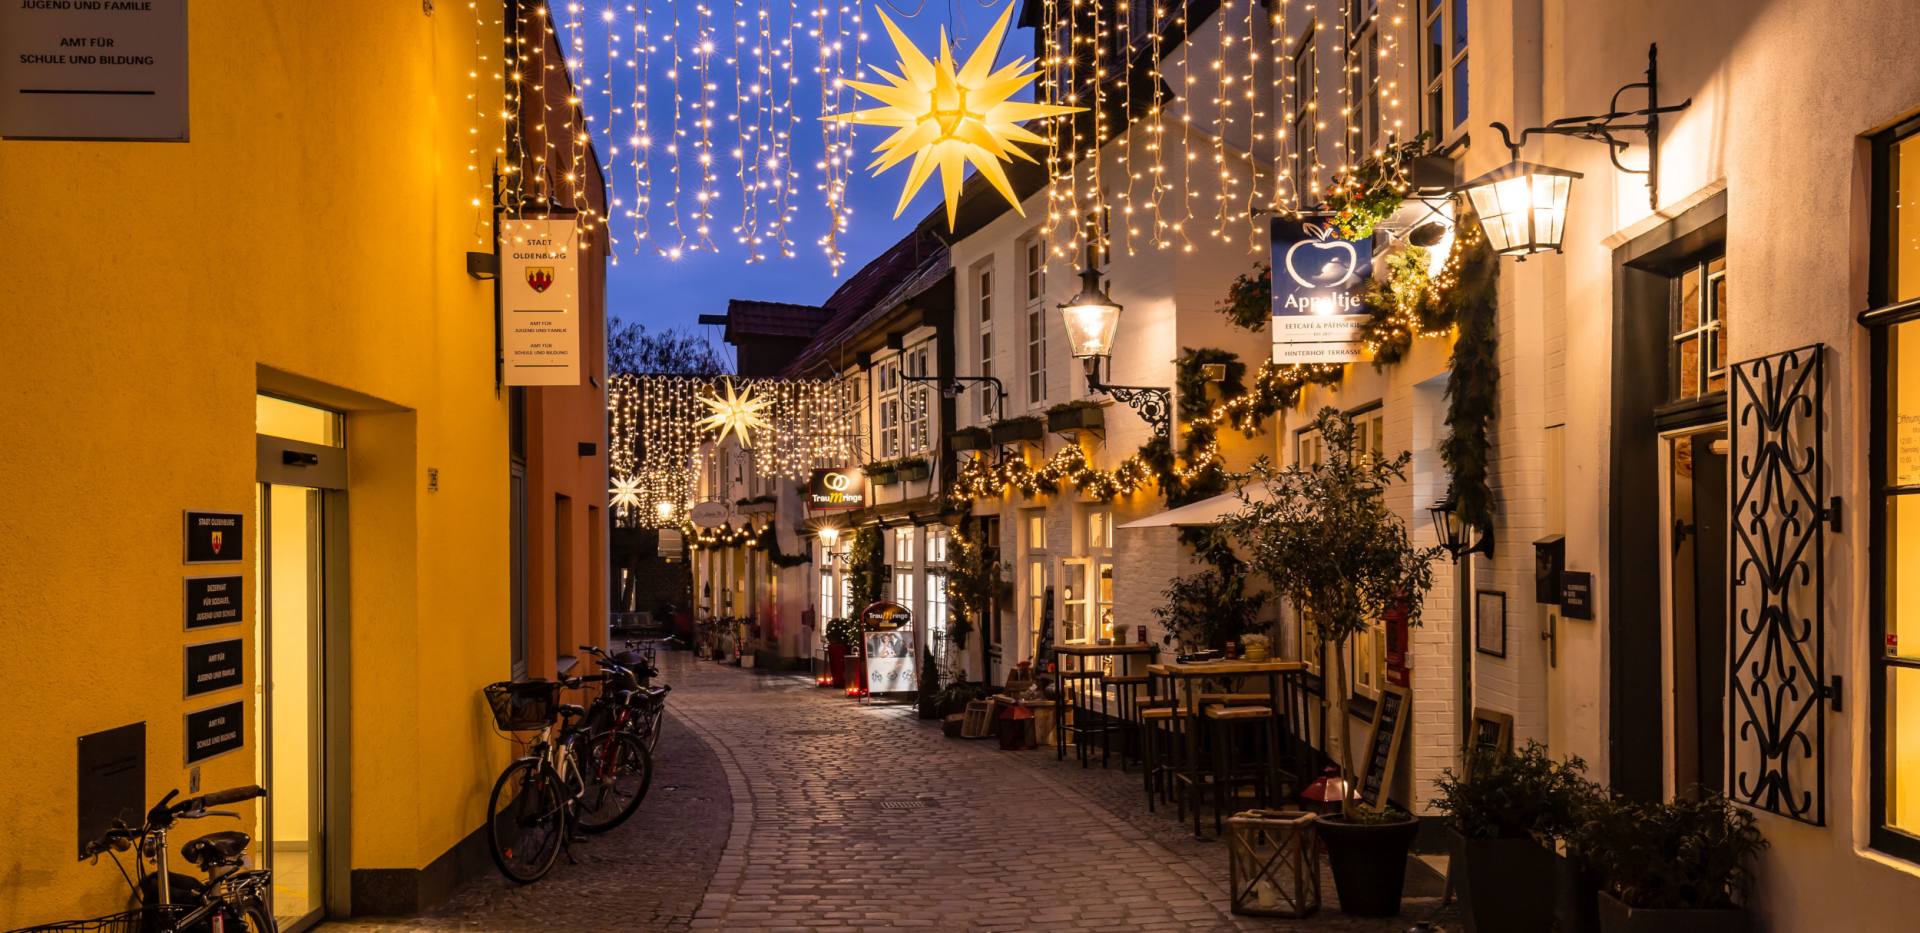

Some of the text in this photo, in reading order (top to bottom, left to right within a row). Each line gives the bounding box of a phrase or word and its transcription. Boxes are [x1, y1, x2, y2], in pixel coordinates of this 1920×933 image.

[21, 0, 152, 11] JUGEND UND FAMILIE
[60, 36, 114, 48] AMT FÜR
[19, 54, 154, 66] SCHULE UND BILDUNG
[512, 252, 567, 260] OLDENBURG
[1328, 349, 1361, 357] TERRASSE
